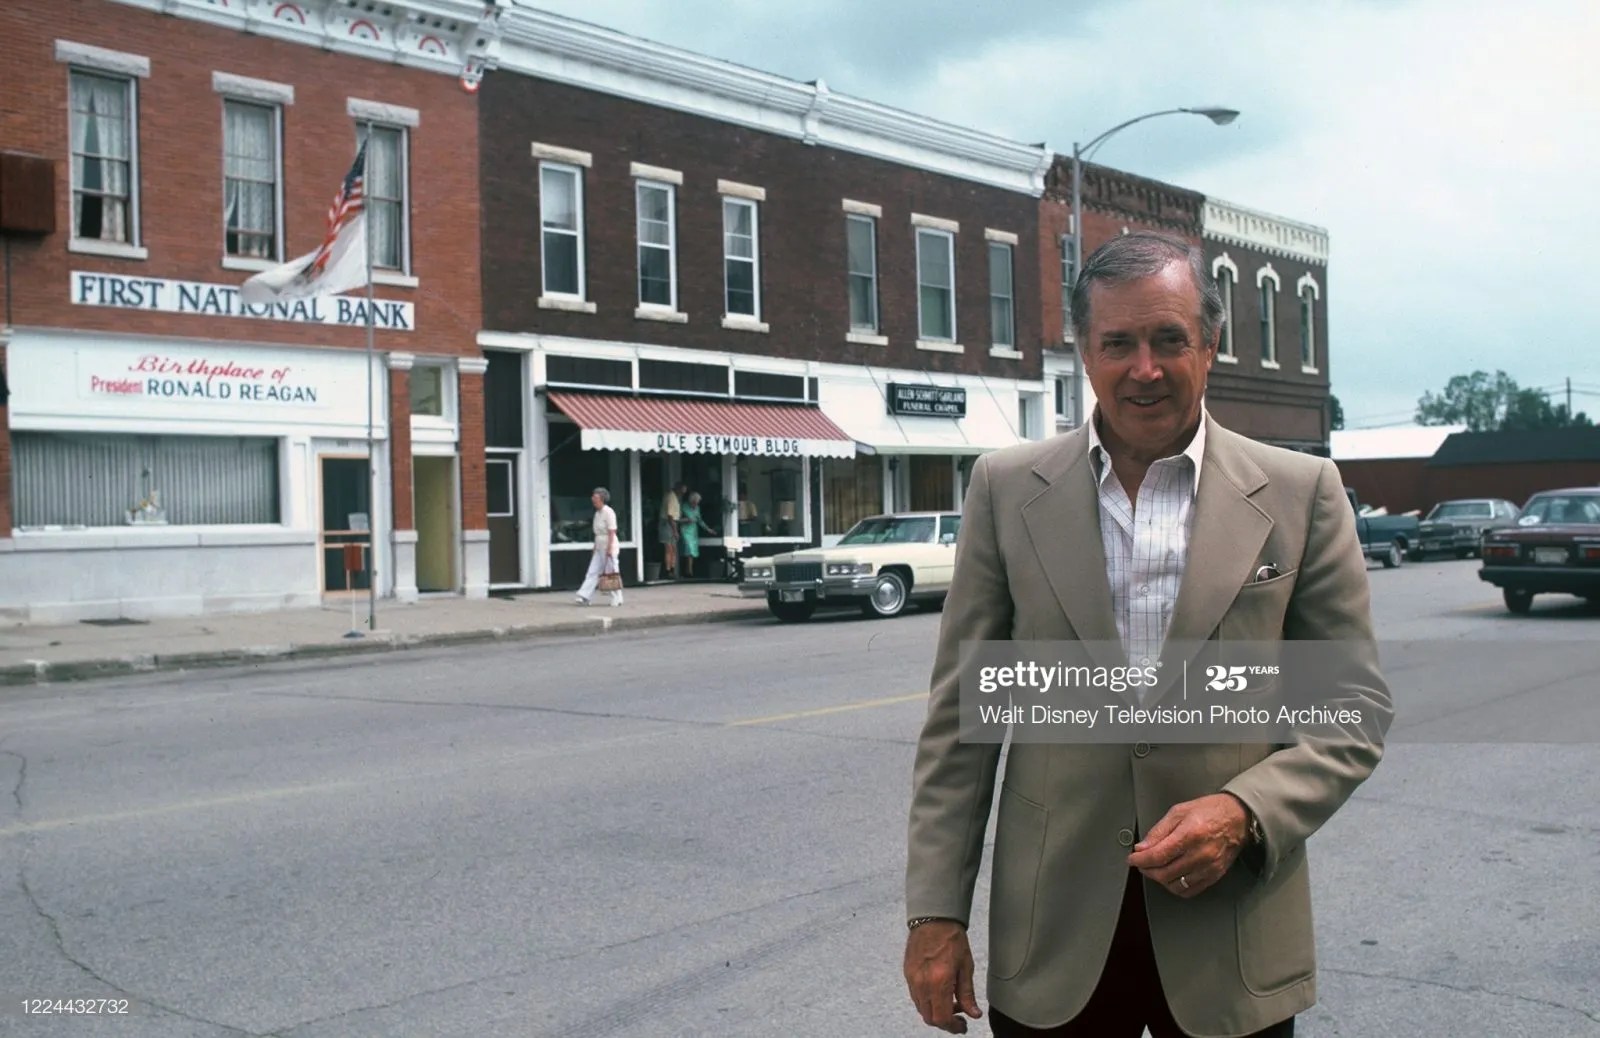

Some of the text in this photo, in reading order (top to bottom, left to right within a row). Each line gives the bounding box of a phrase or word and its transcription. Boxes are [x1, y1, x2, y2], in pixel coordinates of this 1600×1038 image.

[79, 275, 164, 309] FIRST
[337, 298, 409, 329] BANK
[128, 354, 291, 384] Birthplace of
[91, 375, 318, 403] President RONALD REAGAN
[695, 435, 758, 452] SEYMOUR
[765, 438, 799, 453] BLDG
